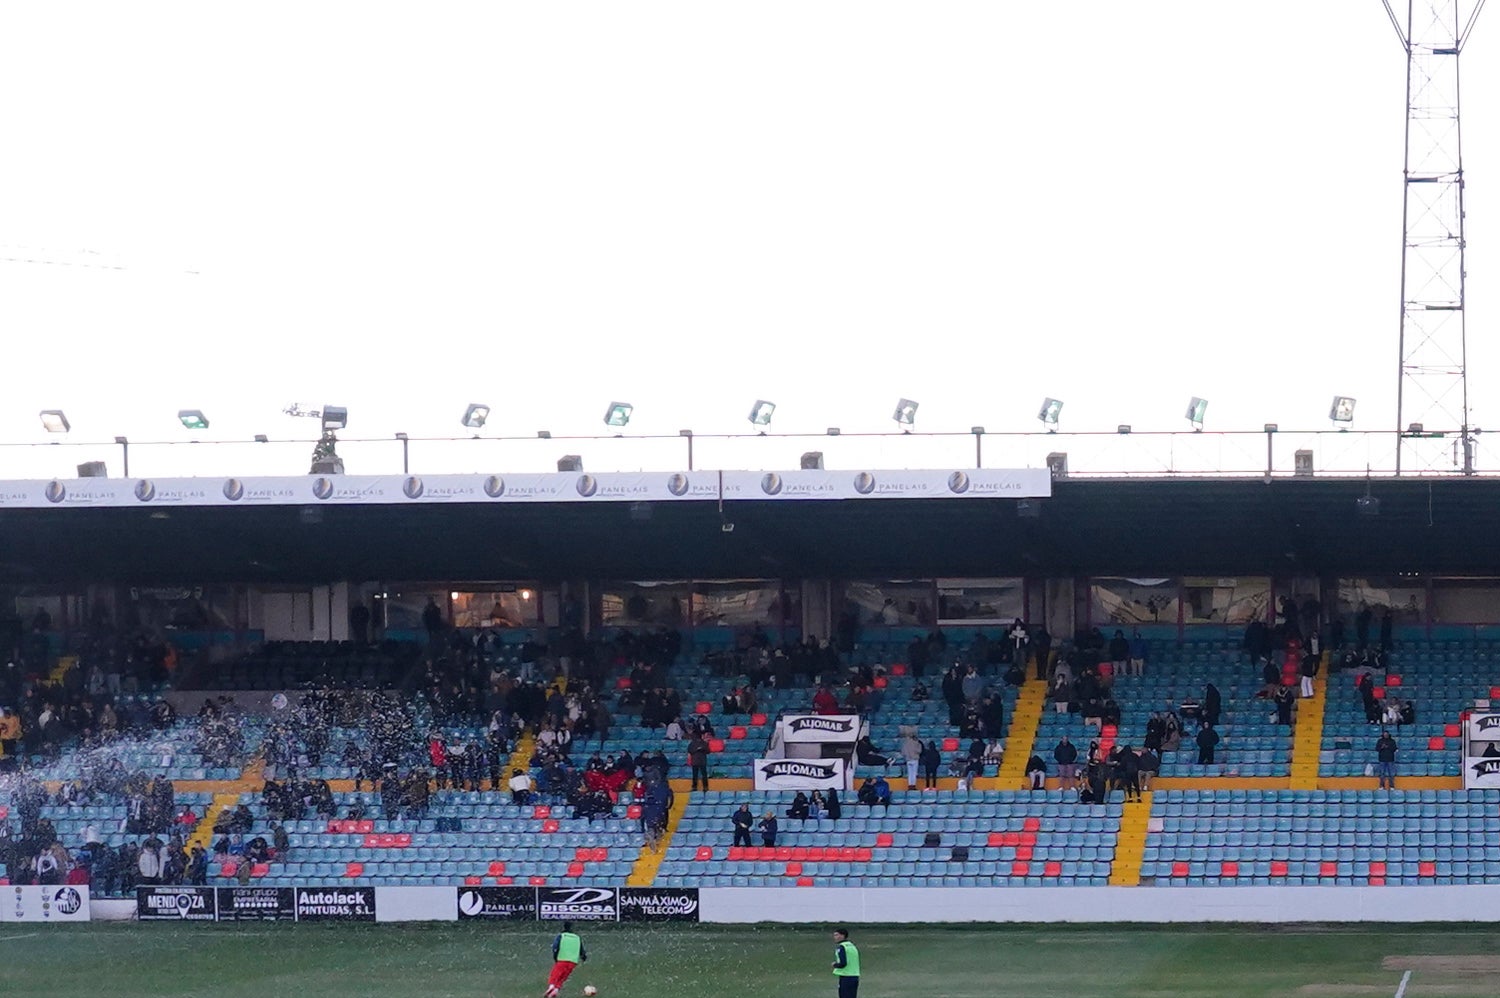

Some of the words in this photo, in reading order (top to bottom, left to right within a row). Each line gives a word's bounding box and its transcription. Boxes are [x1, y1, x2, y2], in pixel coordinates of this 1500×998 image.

[508, 487, 556, 495] PANELAIS
[601, 486, 648, 494] PANELAIS
[973, 483, 1022, 491] PANELAIS
[800, 719, 843, 731] ALJOMAR
[773, 763, 825, 777] ALJOMAR
[147, 894, 205, 909] MENDOZA
[300, 891, 366, 905] Autolack
[299, 906, 352, 915] PINTURAS,
[356, 906, 374, 915] S.L.
[485, 904, 535, 912] PANELAIS
[641, 906, 686, 915] TELECOM
